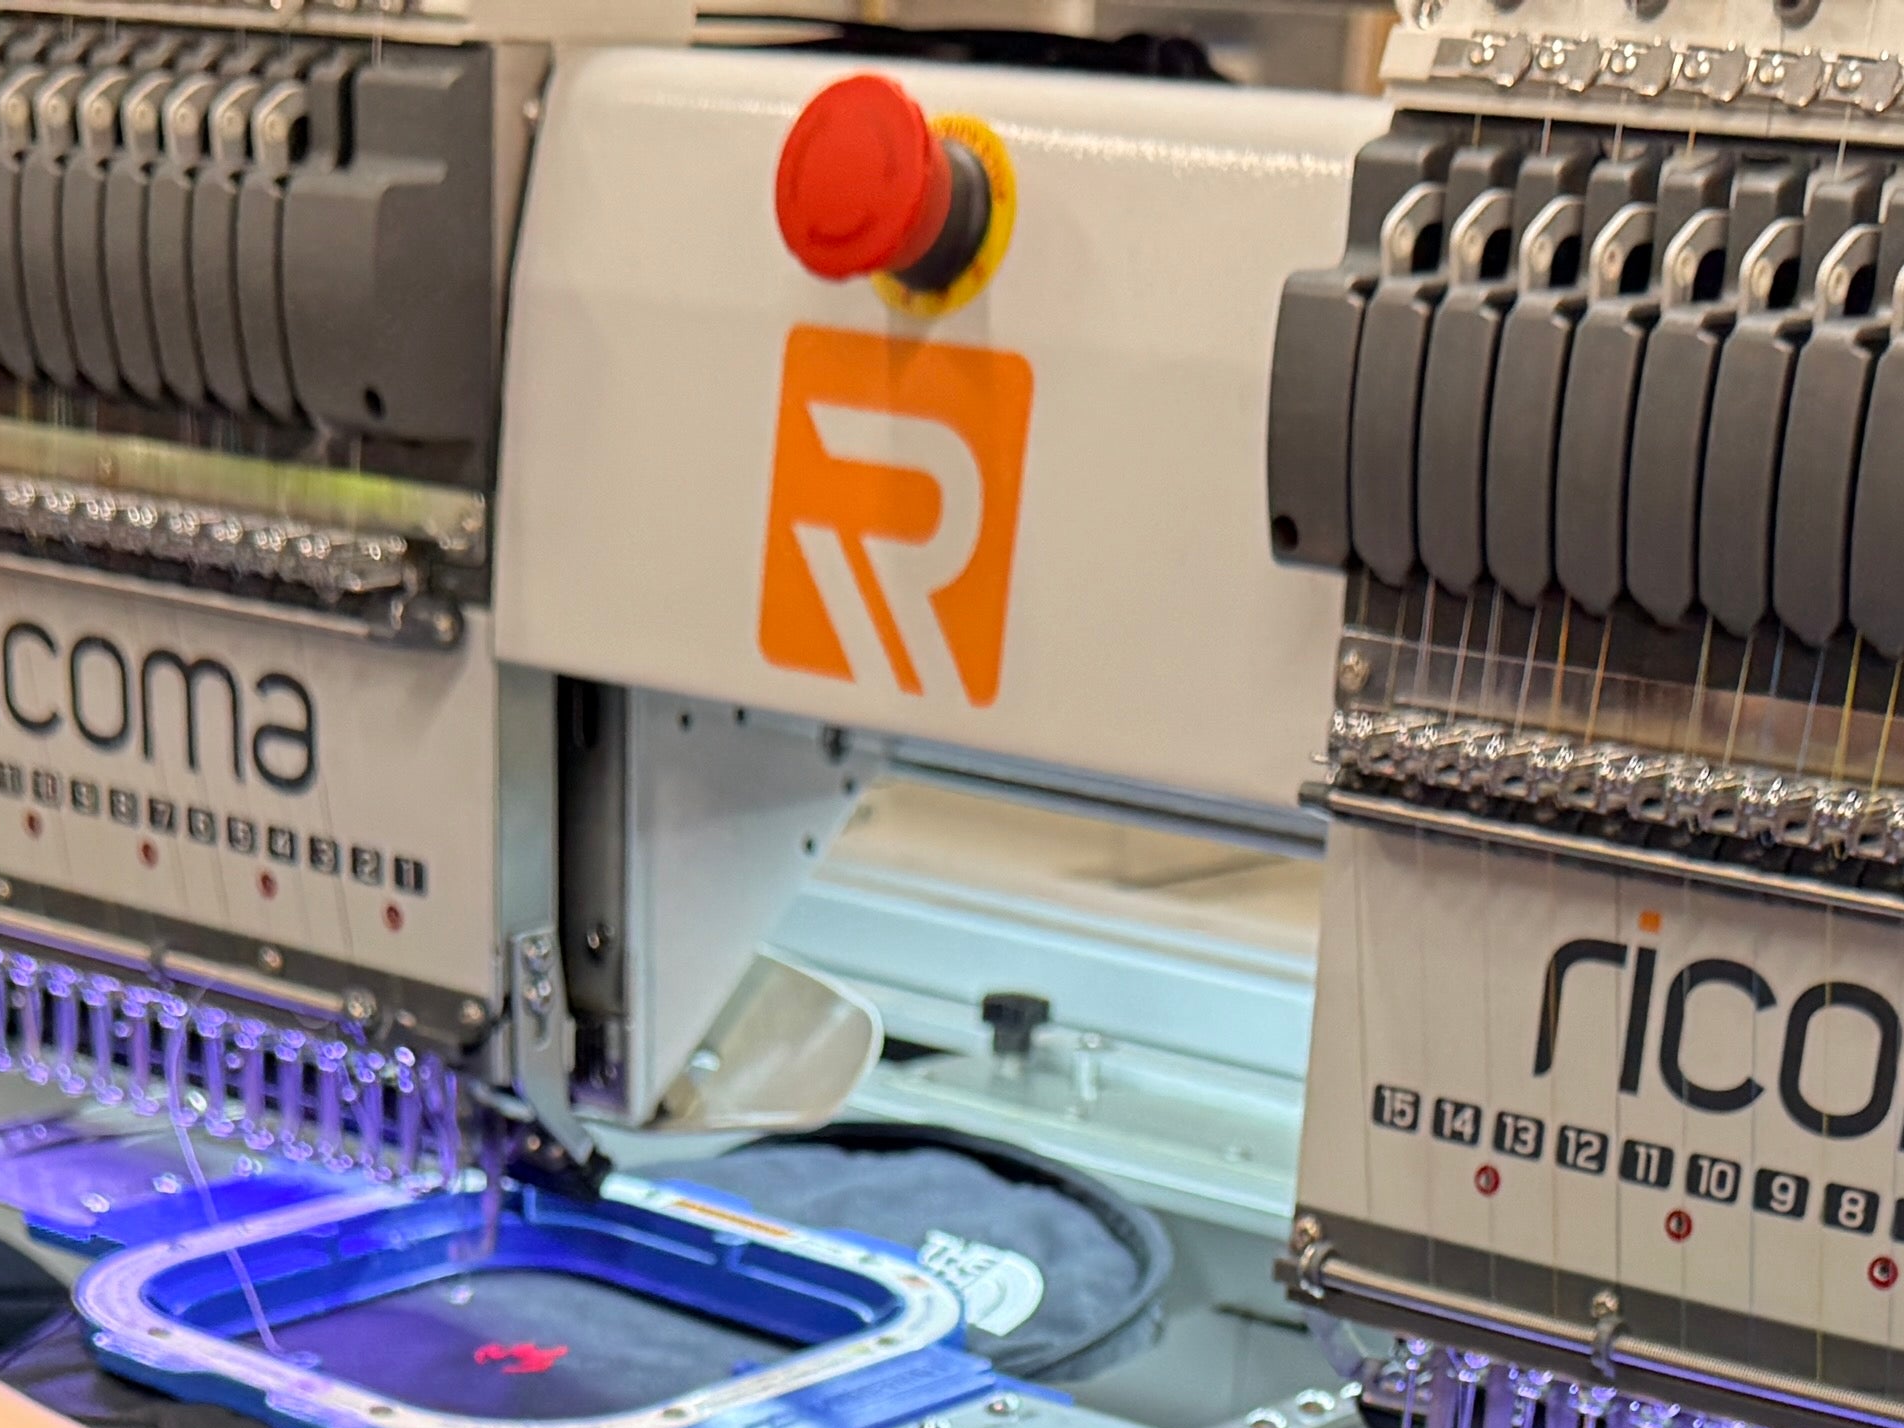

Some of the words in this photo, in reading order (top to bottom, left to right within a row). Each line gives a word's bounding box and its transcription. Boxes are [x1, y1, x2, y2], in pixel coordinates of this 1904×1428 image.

[1379, 1088, 1415, 1129] 15
[1440, 1101, 1476, 1142] 14
[1501, 1114, 1537, 1156] 13
[1564, 1129, 1600, 1170] 12
[1634, 1143, 1662, 1184] 11
[1696, 1157, 1735, 1201] 10
[1769, 1174, 1796, 1214] 9
[1837, 1188, 1867, 1230] 8
